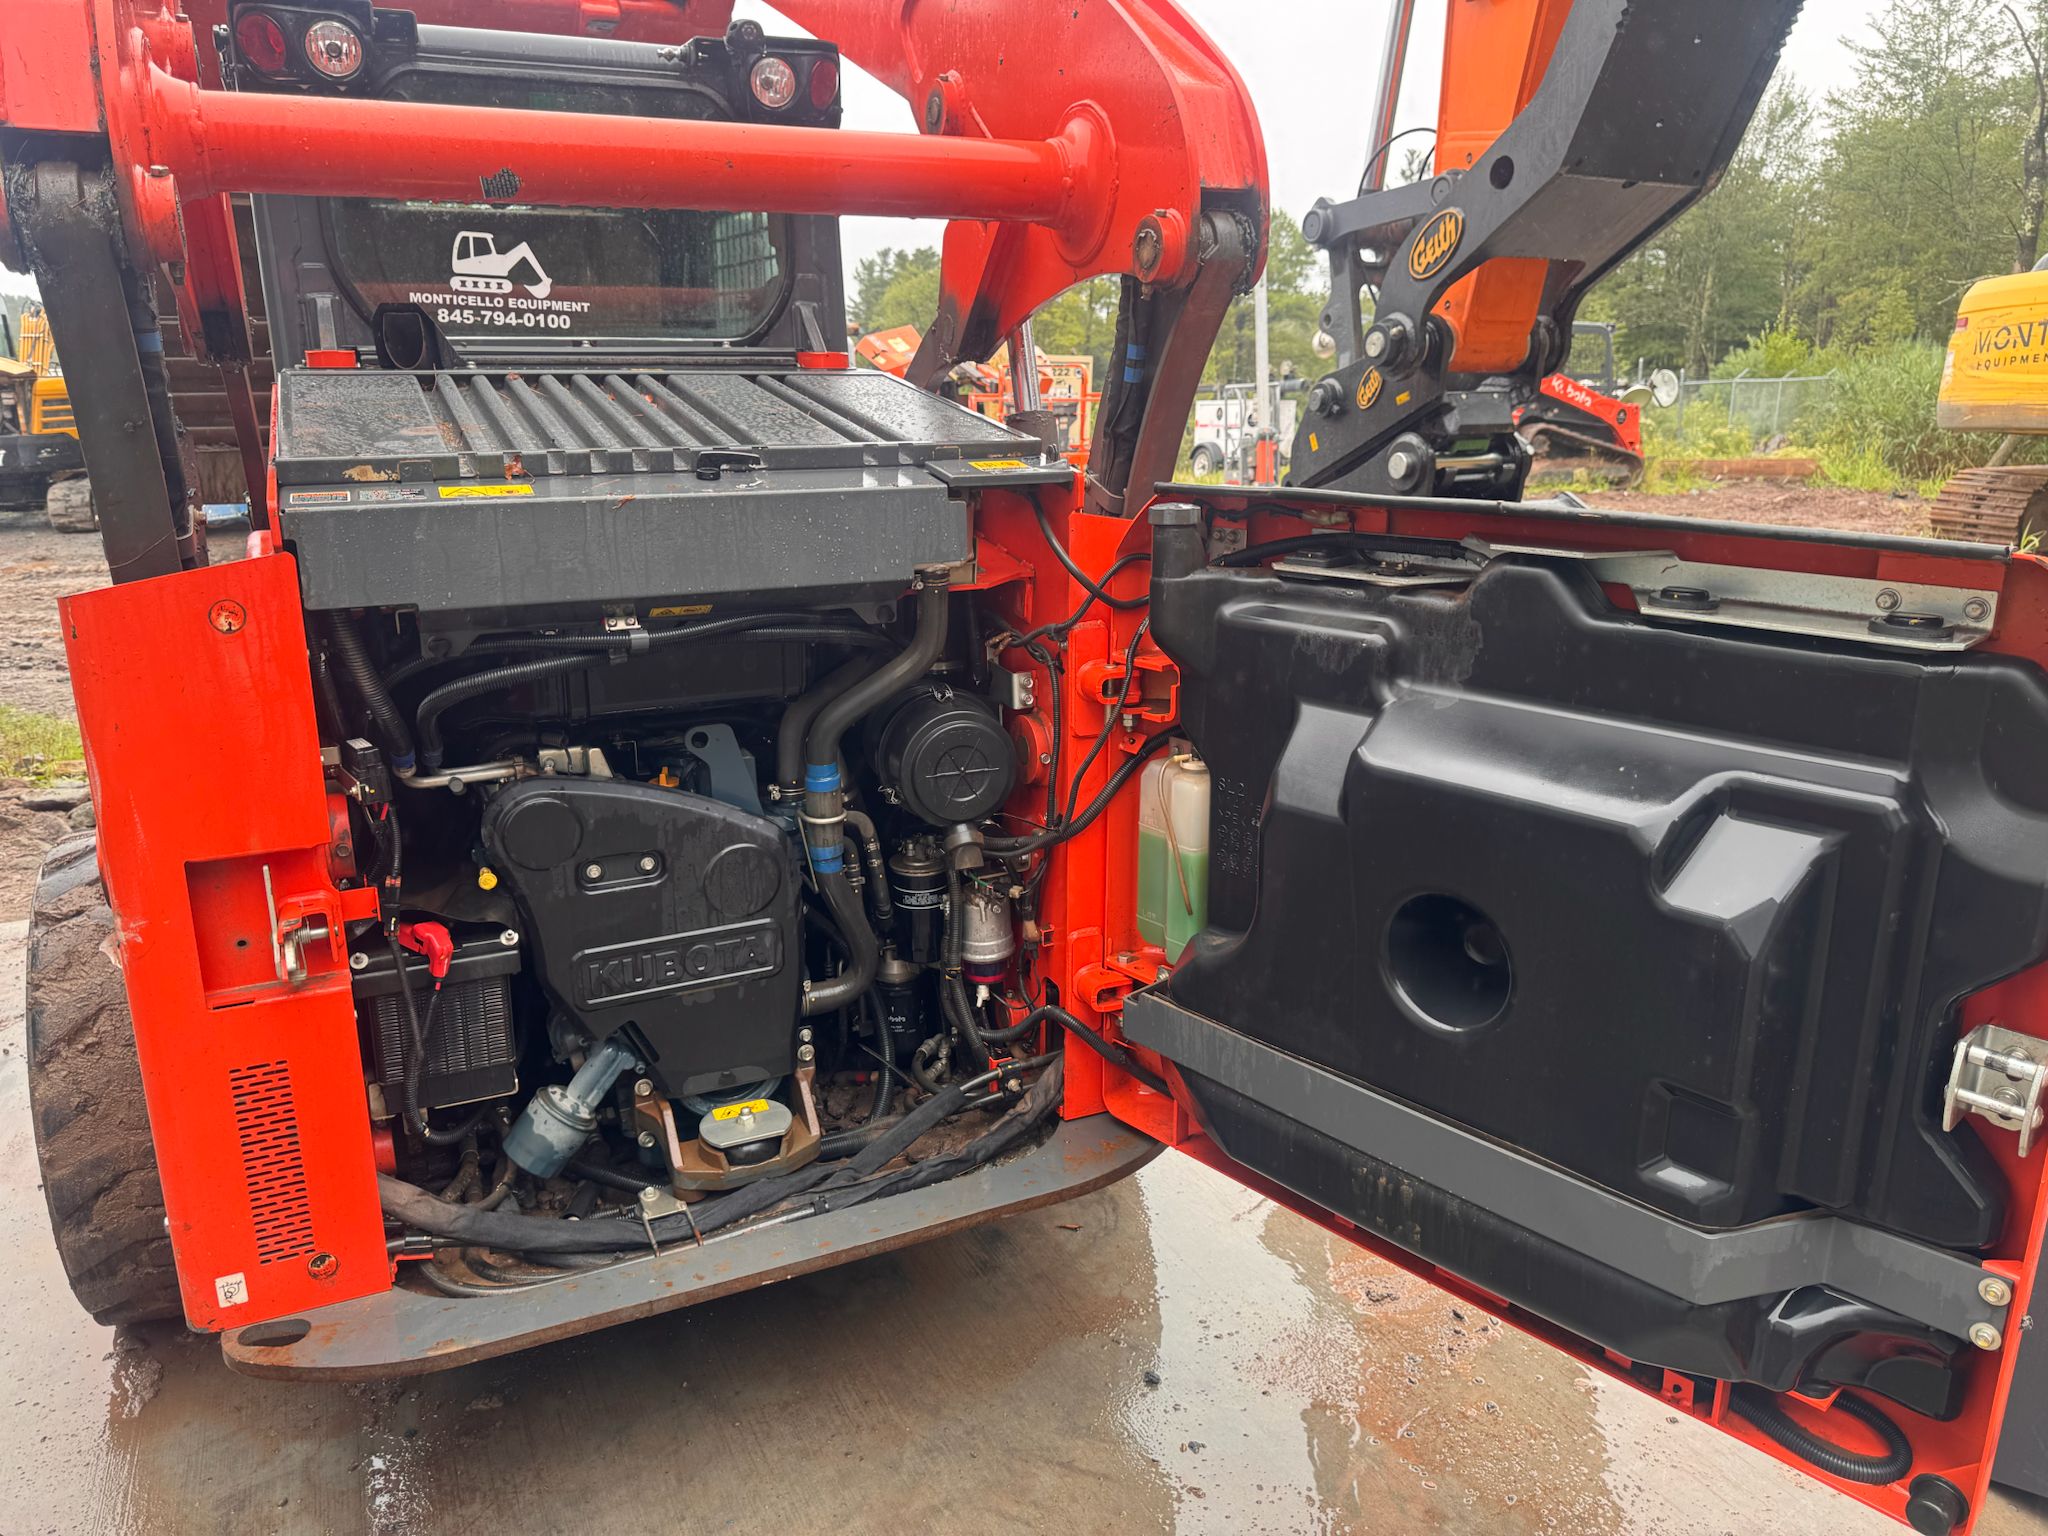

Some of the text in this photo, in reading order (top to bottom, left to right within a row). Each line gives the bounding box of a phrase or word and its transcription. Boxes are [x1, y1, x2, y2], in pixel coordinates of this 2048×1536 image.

[409, 292, 590, 313] MONTICELLO EQUIPMENT
[437, 308, 571, 329] 845-794-0100
[589, 936, 769, 996] KUBOTA
